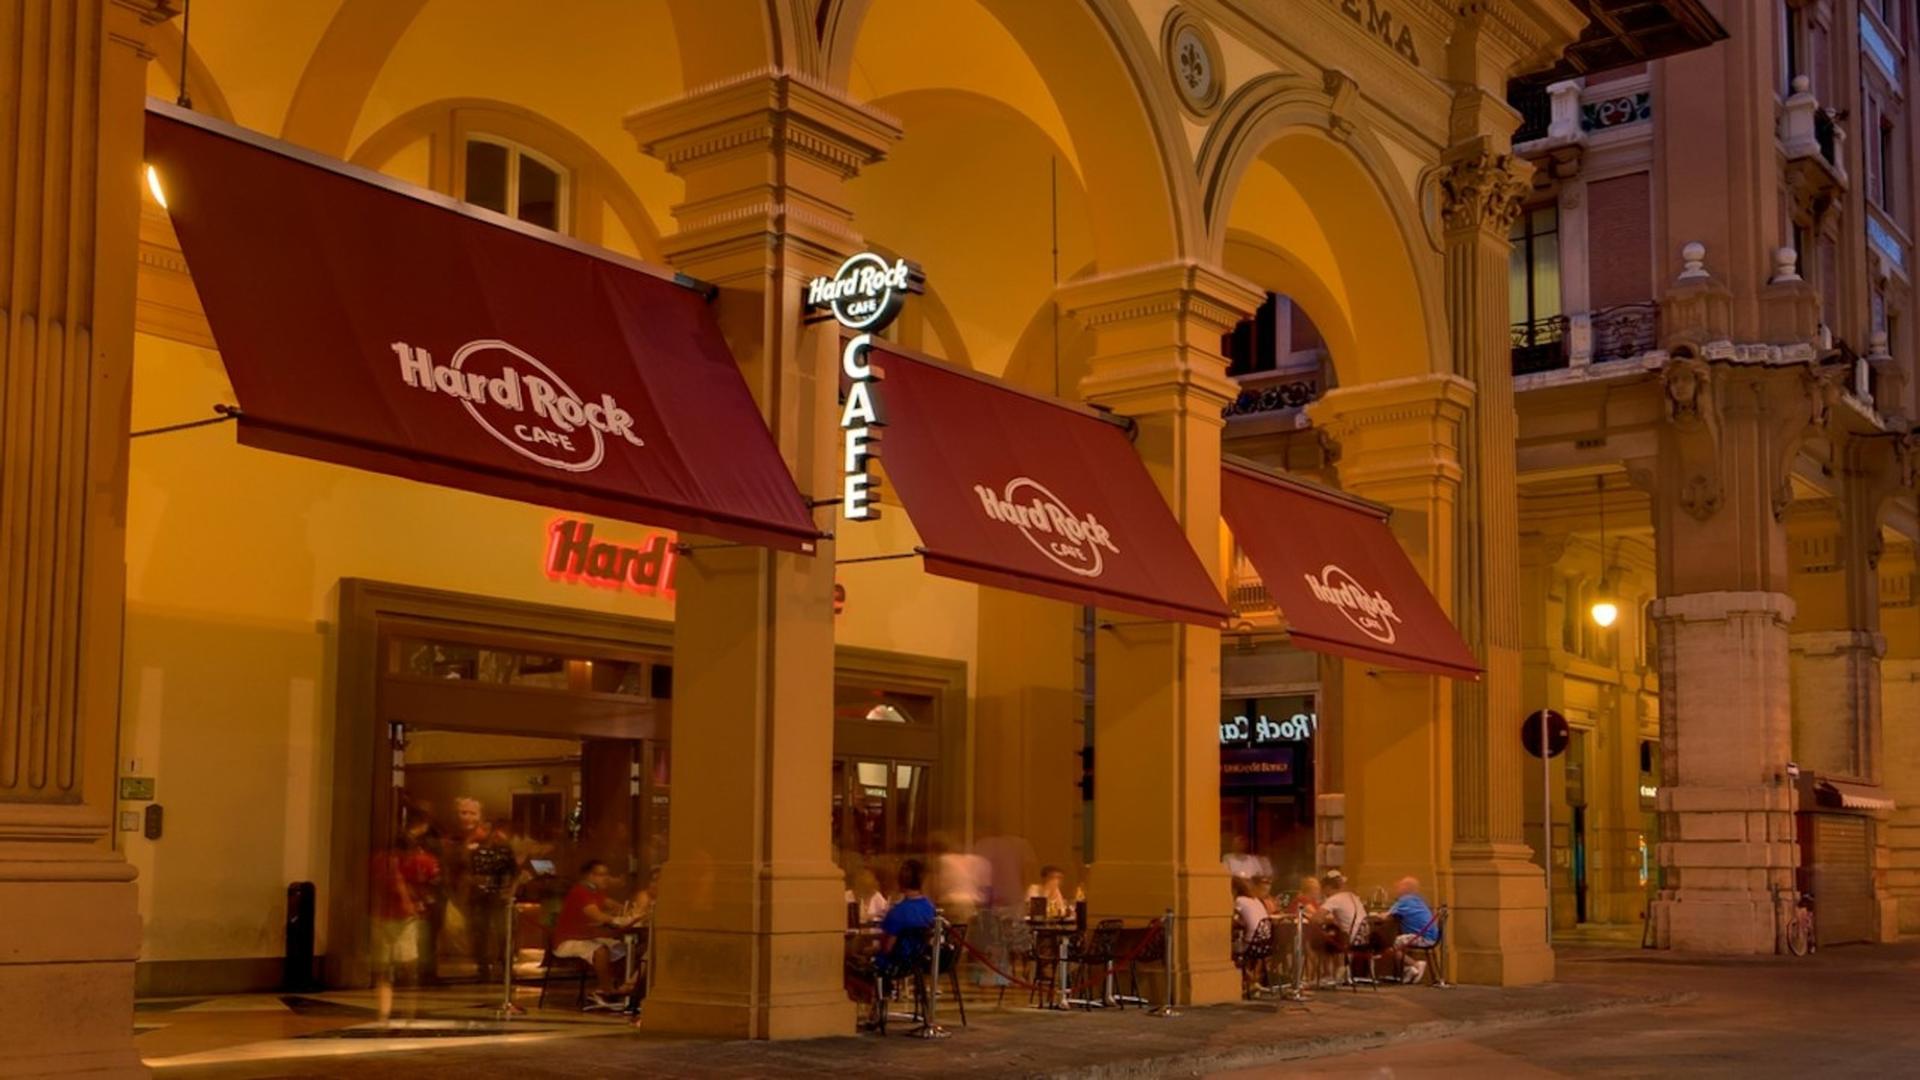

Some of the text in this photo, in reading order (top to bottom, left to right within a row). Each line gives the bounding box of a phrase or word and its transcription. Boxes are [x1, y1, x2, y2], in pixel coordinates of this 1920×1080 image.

[1341, 0, 1420, 67] EMA
[808, 258, 908, 304] Hard Rock
[847, 299, 877, 316] CAFE
[391, 341, 645, 447] Hard Rock
[841, 334, 877, 518] CAFE
[514, 424, 576, 452] CAFE
[974, 485, 1121, 554] Hard Rock
[547, 518, 669, 590] Hard
[1304, 573, 1402, 624] Hard Rock
